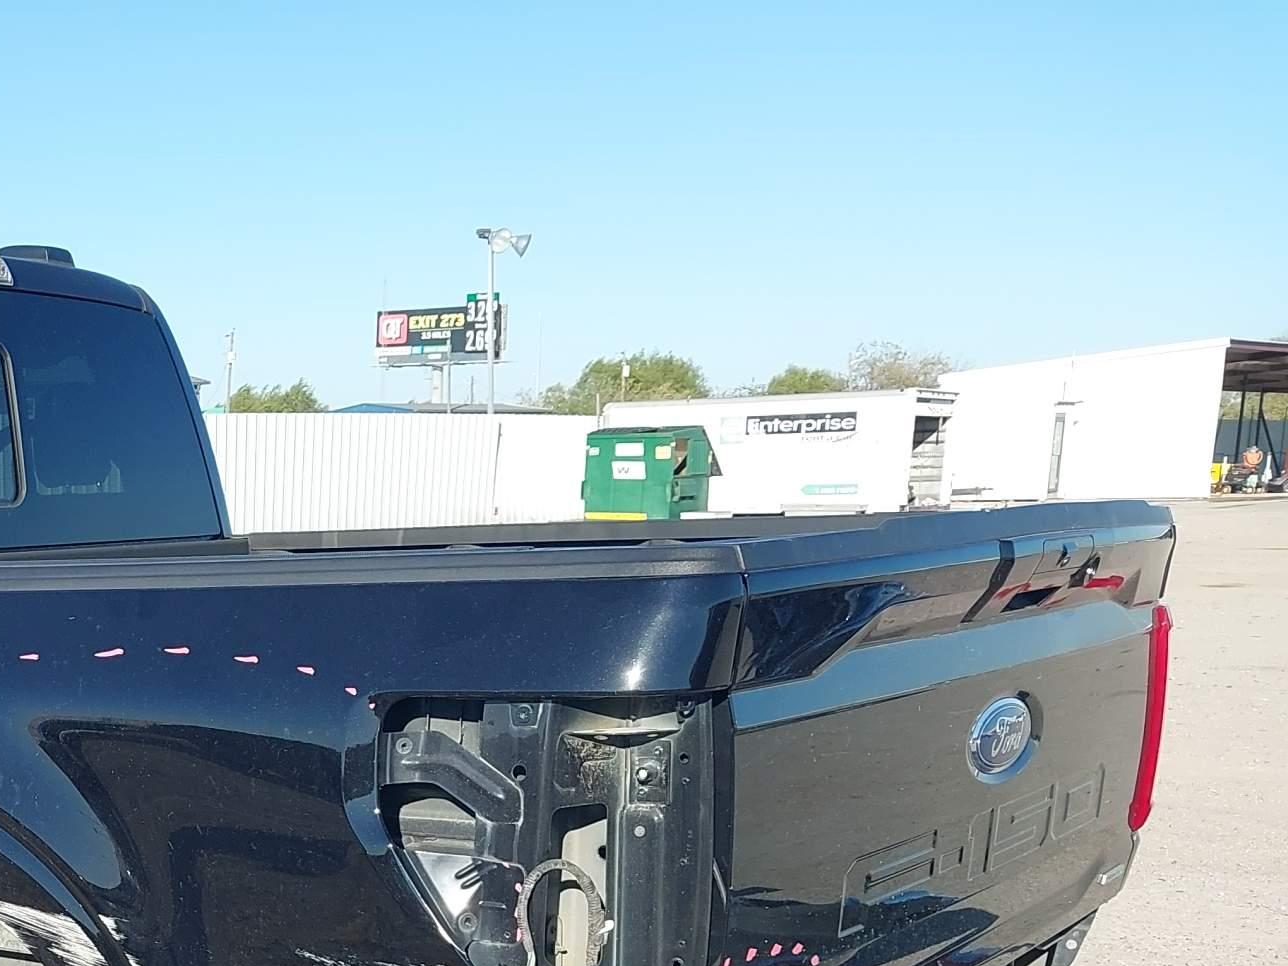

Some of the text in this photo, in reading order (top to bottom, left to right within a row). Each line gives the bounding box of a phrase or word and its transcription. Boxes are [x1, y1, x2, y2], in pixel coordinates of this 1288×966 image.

[409, 313, 464, 330] EXIT 273
[747, 414, 856, 433] Enterprise
[988, 714, 1025, 757] Ford
[837, 762, 1106, 938] F-150
